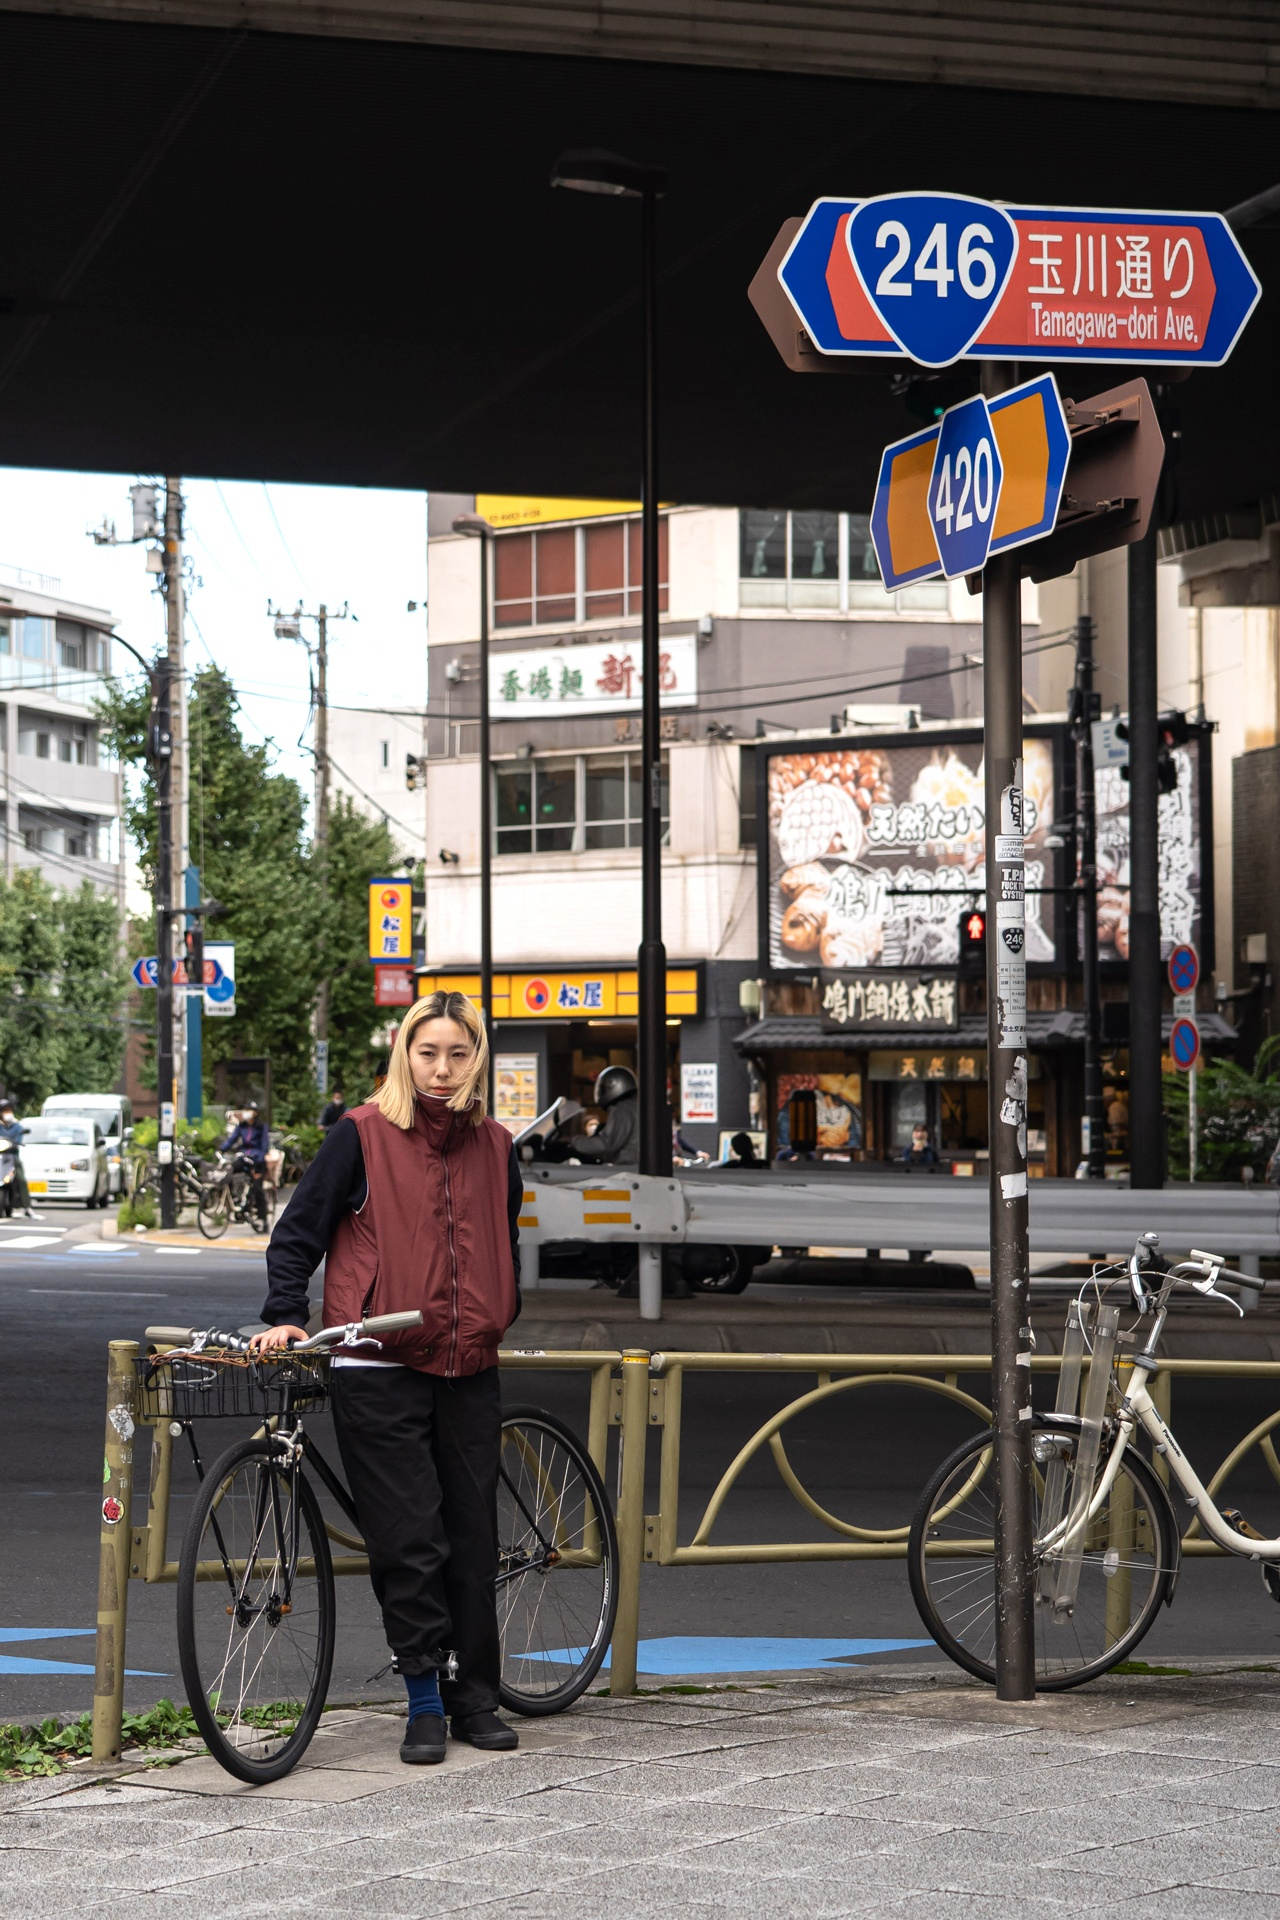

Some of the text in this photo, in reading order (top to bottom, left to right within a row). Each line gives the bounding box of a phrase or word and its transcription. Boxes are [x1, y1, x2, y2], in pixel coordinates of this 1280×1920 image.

[875, 220, 996, 300] 246
[1028, 233, 1194, 299] 玉川通り
[1031, 302, 1198, 345] Tamagawa-dori Ave.
[936, 437, 993, 536] 420
[1001, 881, 1018, 891] FUCK
[381, 914, 400, 953] 松屋
[1005, 934, 1024, 945] 246
[557, 982, 602, 1008] 松屋
